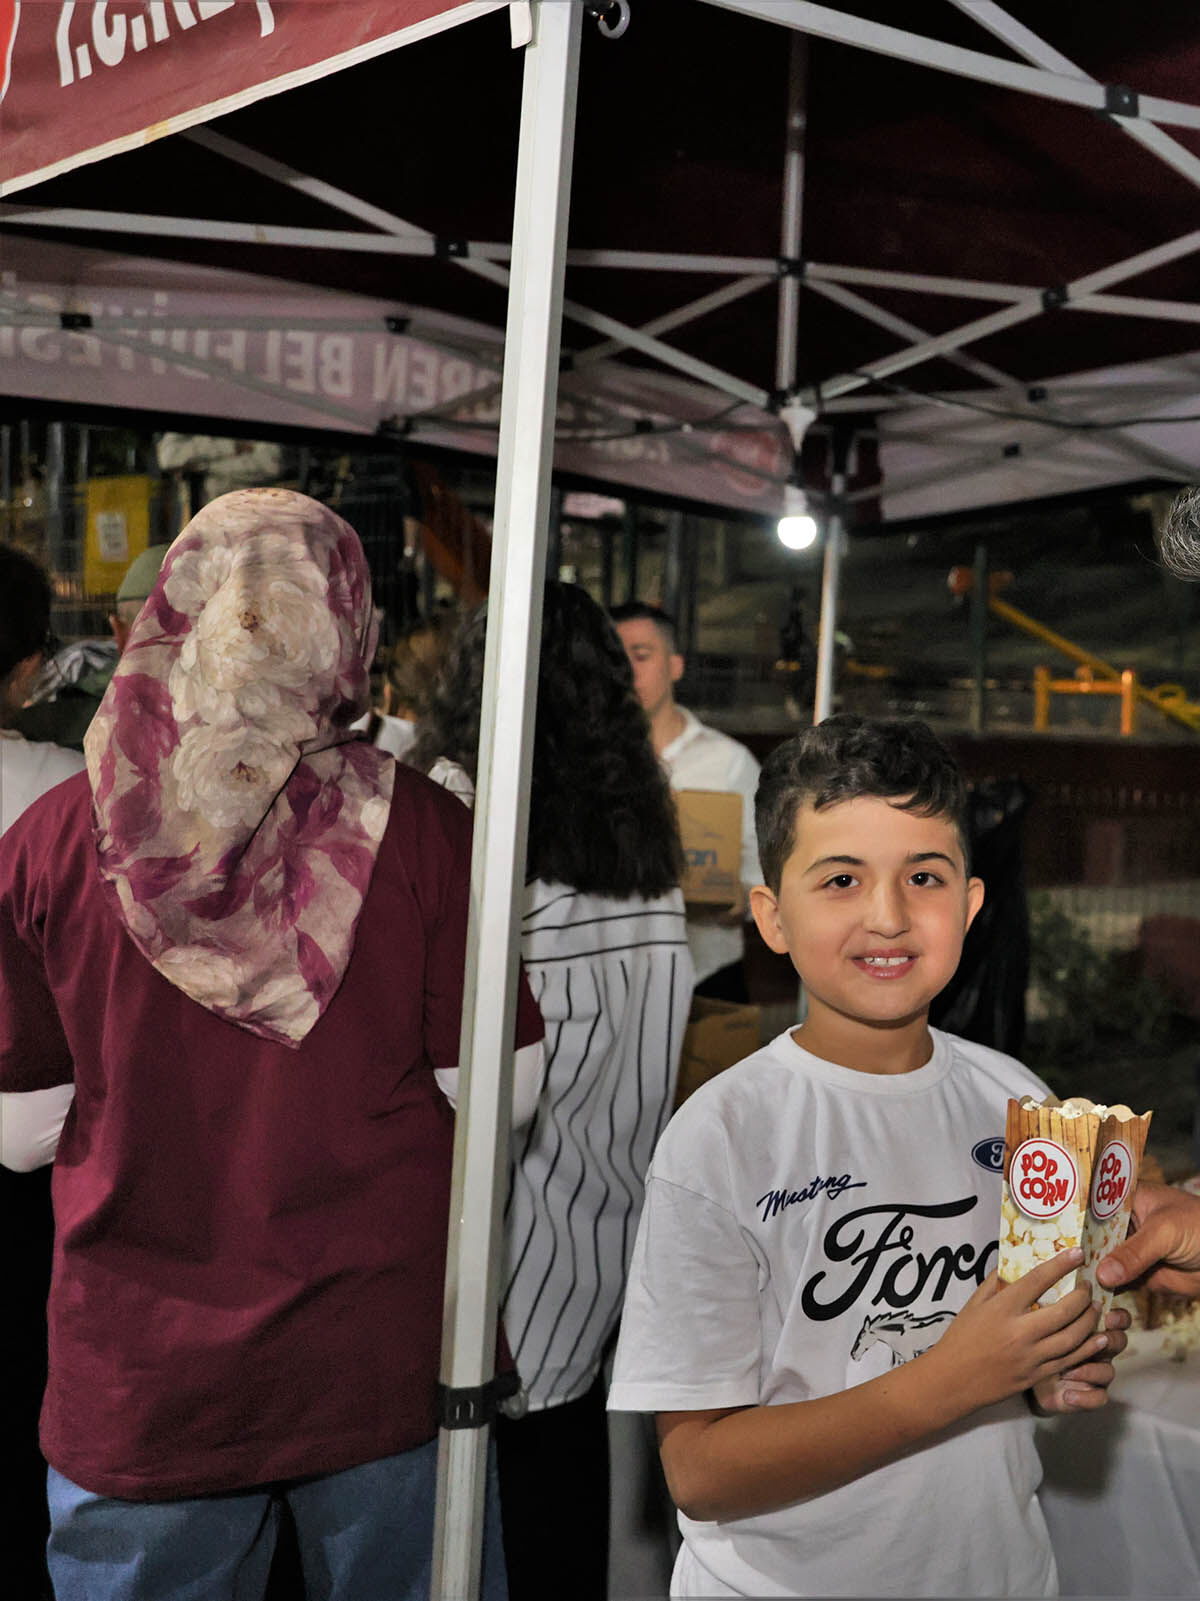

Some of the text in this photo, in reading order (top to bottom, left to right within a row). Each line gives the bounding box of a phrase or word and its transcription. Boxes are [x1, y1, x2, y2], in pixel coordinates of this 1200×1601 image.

[1021, 1150, 1058, 1180] POP
[1101, 1153, 1122, 1180] POP
[1020, 1177, 1069, 1207] CORN
[1096, 1176, 1127, 1206] CORN
